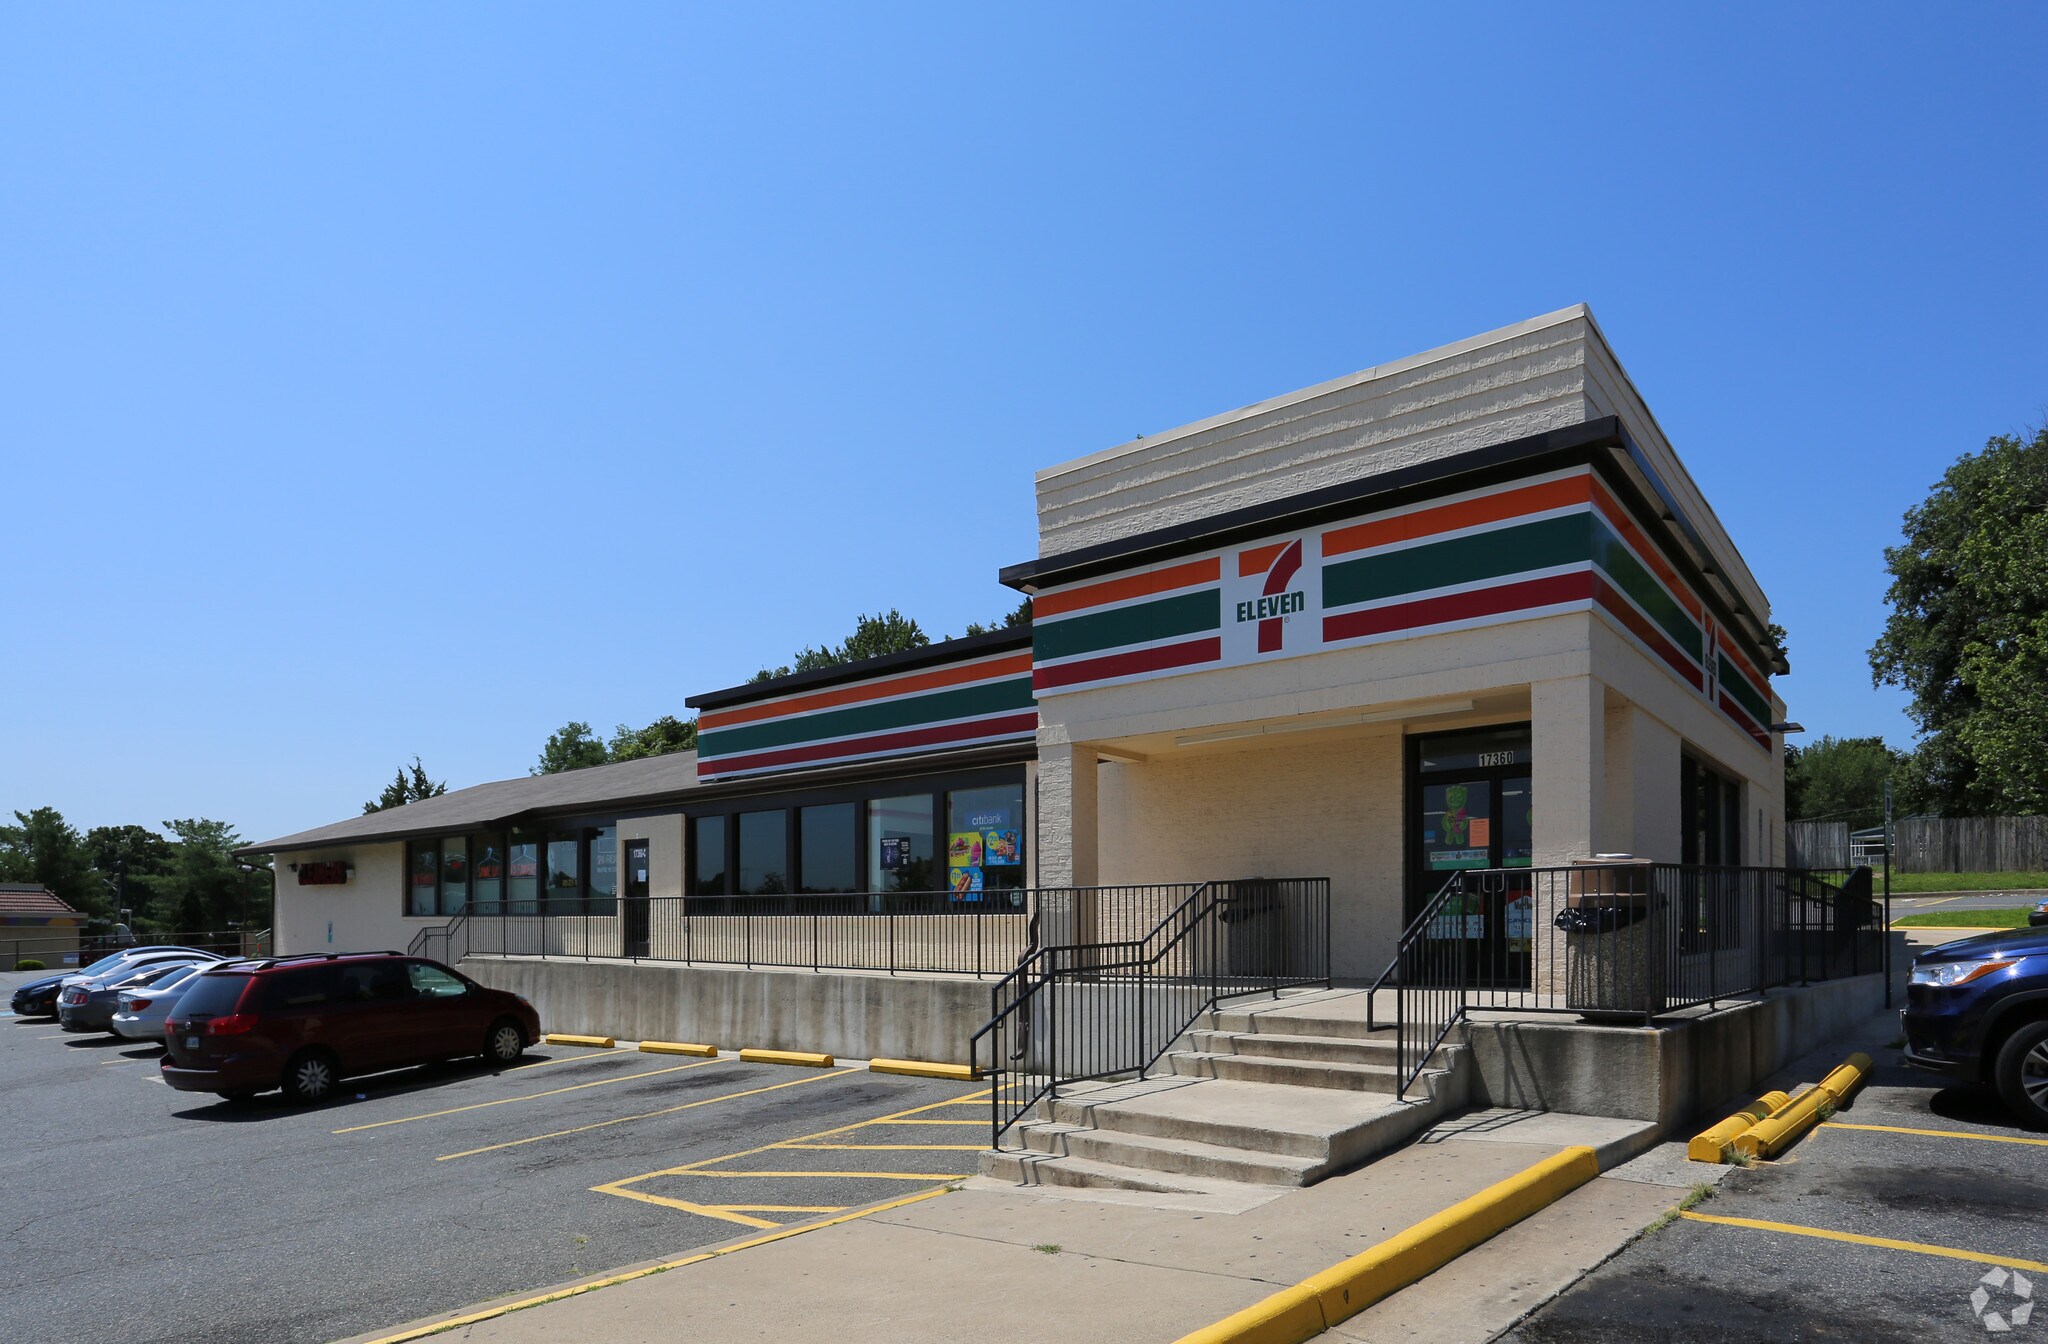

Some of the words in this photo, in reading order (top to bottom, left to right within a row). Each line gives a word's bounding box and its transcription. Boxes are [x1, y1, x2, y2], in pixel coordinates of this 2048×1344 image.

[1239, 538, 1302, 653] 7
[1480, 751, 1513, 766] 17360
[971, 813, 1002, 826] citibank
